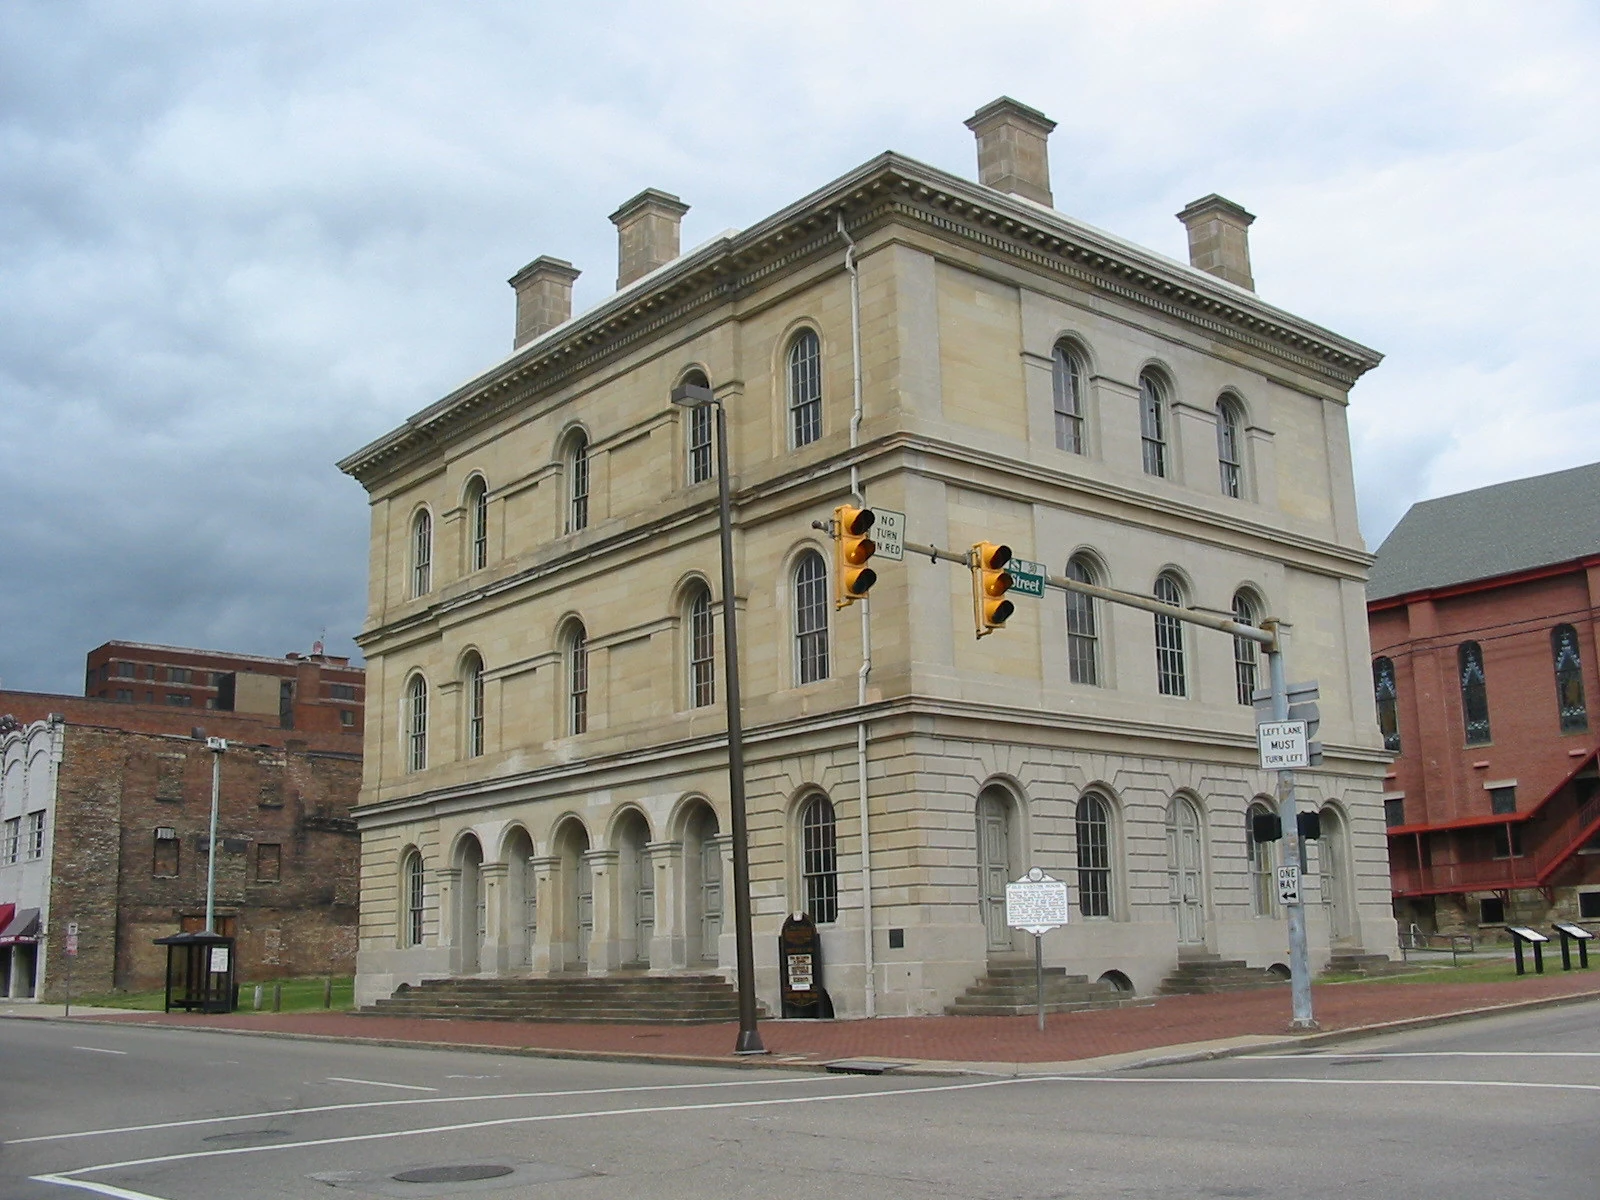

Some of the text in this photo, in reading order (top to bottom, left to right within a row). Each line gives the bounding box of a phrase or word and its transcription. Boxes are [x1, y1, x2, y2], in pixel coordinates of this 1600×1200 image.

[881, 515, 895, 527] NO
[877, 527, 898, 540] TURN
[885, 543, 901, 555] RED
[1011, 573, 1040, 593] Street
[1262, 726, 1302, 737] LEFT LANE
[1271, 740, 1295, 750] MUST
[1265, 754, 1303, 764] TURN LEFT
[1280, 868, 1296, 879] ONE
[1280, 880, 1297, 889] WAY
